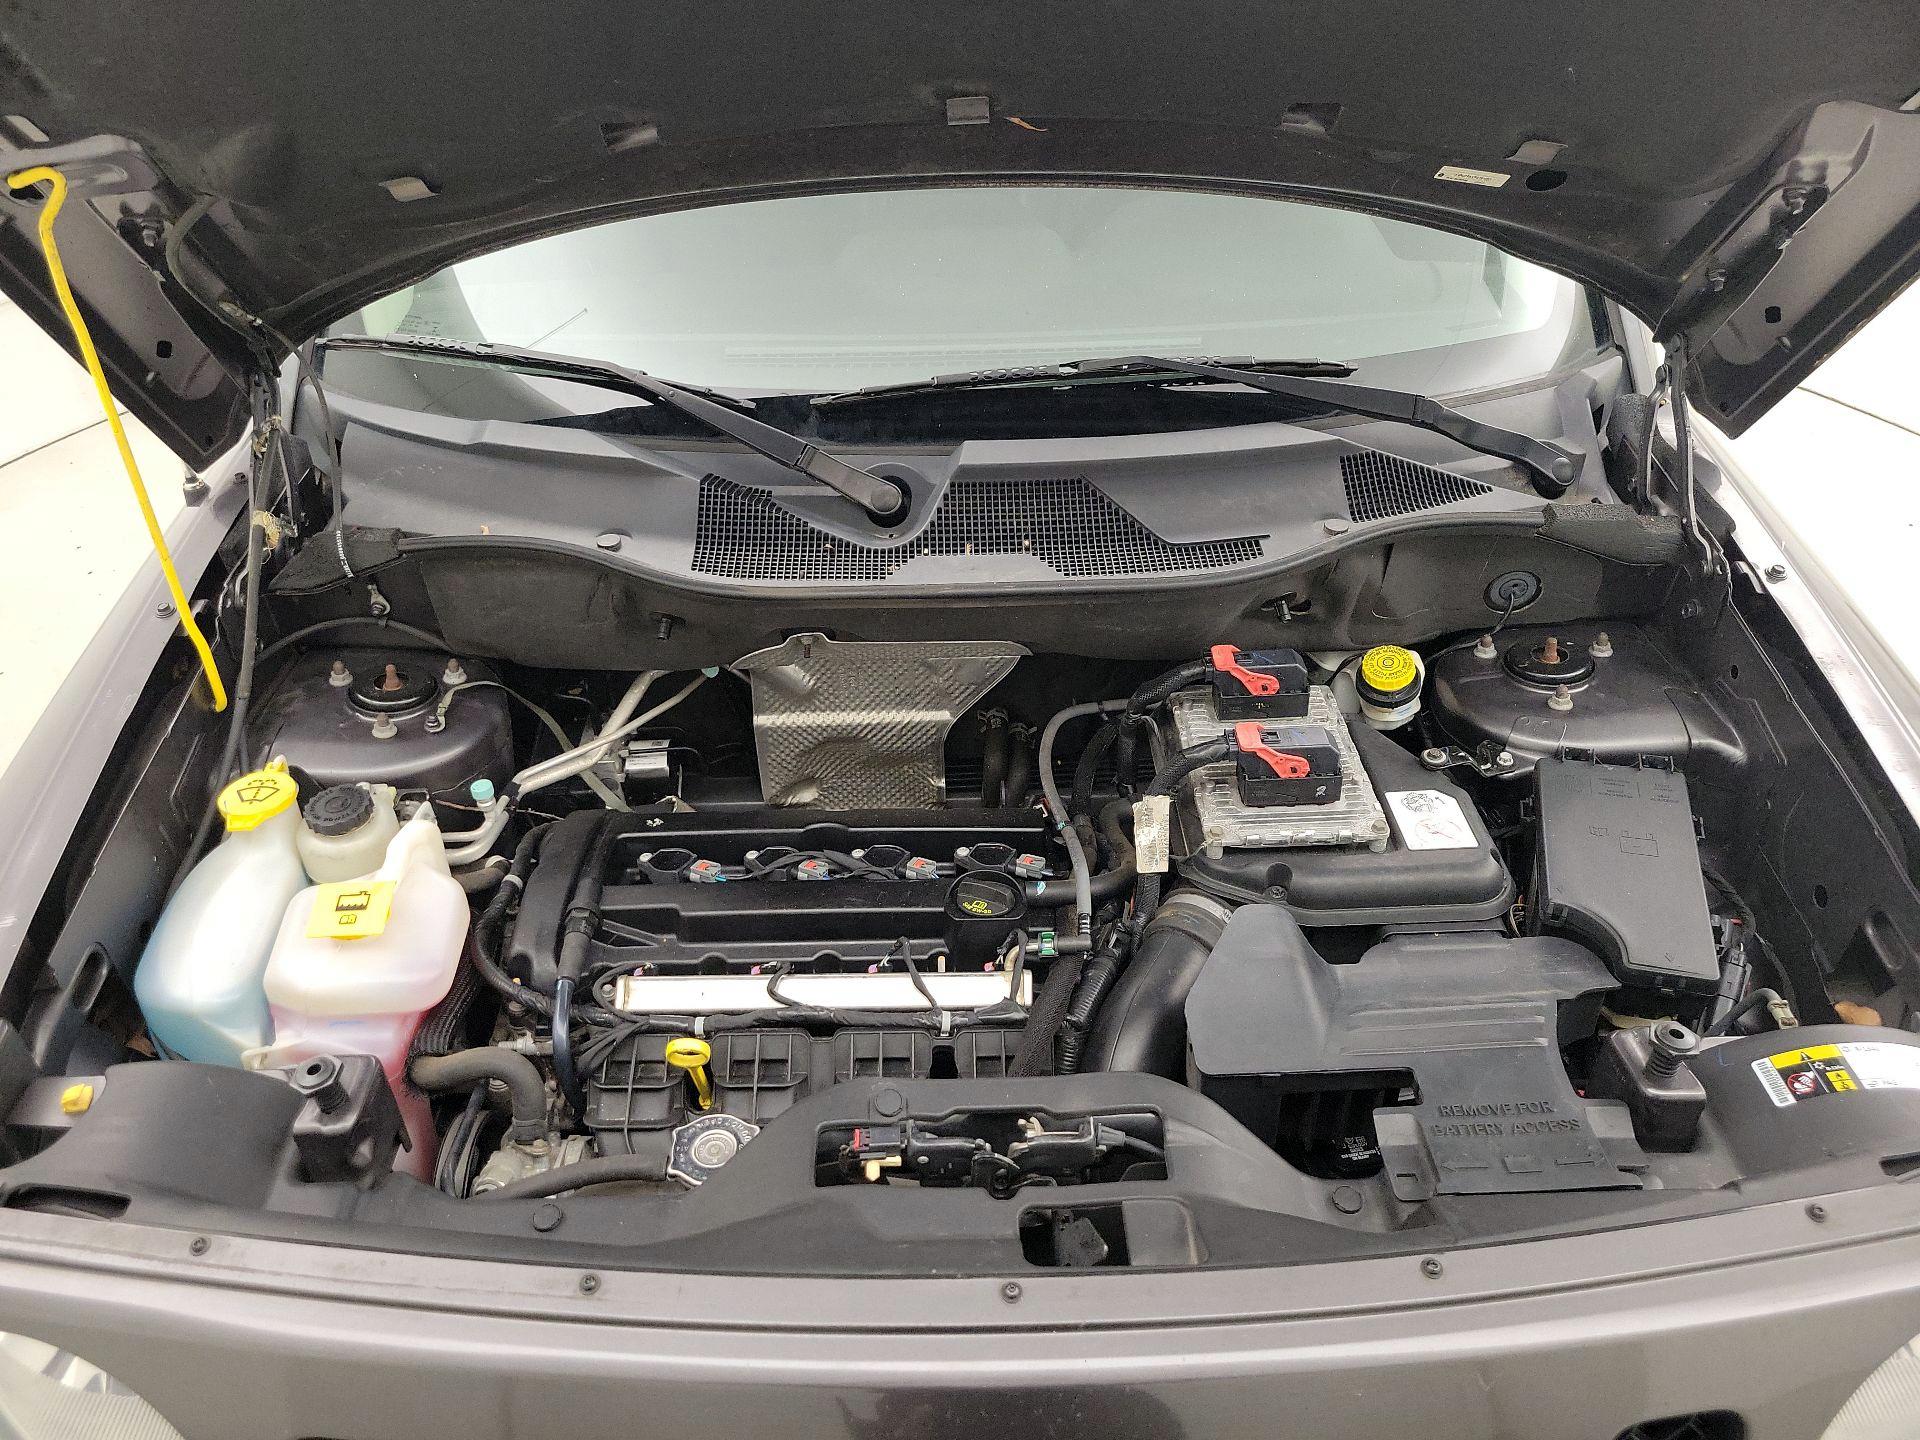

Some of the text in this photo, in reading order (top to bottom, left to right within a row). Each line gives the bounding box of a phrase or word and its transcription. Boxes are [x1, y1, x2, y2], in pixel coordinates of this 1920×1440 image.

[1439, 1101, 1555, 1117] REMOVE FOR
[1432, 1118, 1581, 1137] BATTERY ACCESS
